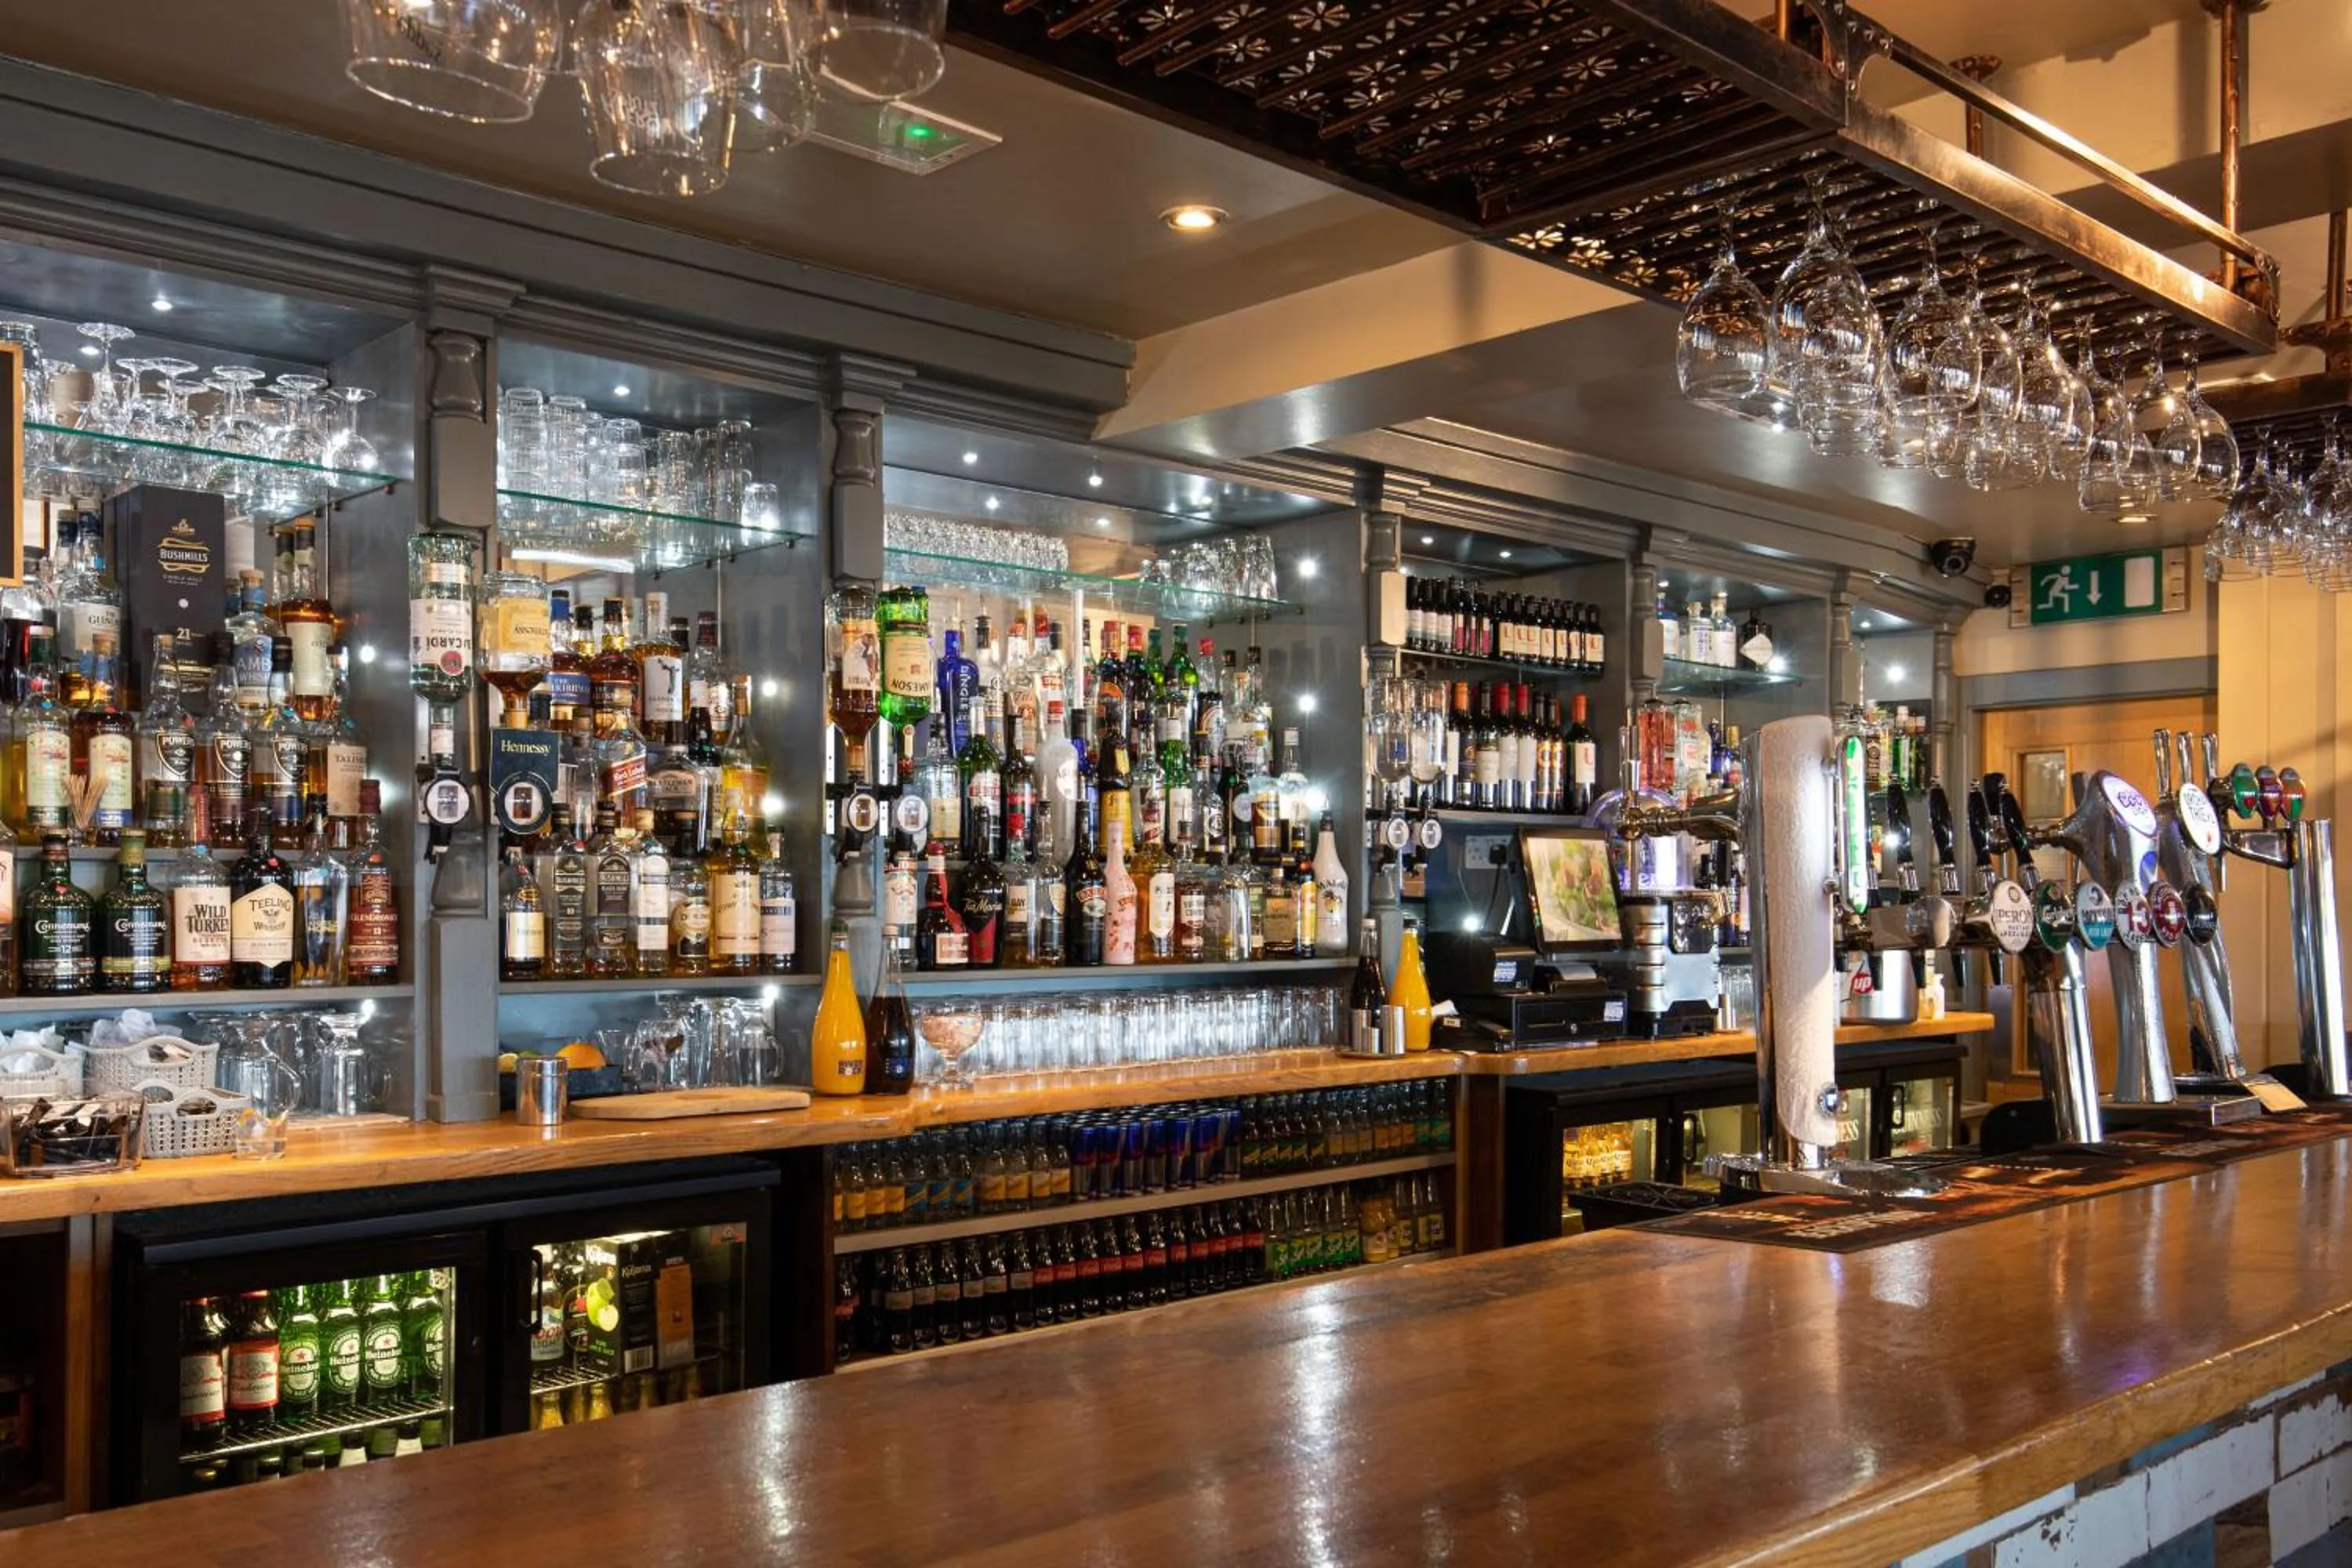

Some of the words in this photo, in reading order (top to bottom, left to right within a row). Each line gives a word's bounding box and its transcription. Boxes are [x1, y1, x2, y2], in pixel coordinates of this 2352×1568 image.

[160, 549, 208, 562] BUSHMILLS
[176, 627, 191, 640] 21
[959, 664, 971, 710] DINGLE
[501, 739, 551, 757] Hennessy
[194, 904, 227, 918] WILD
[249, 898, 291, 912] TEELING
[2127, 899, 2151, 934] 13
[60, 945, 71, 954] 12
